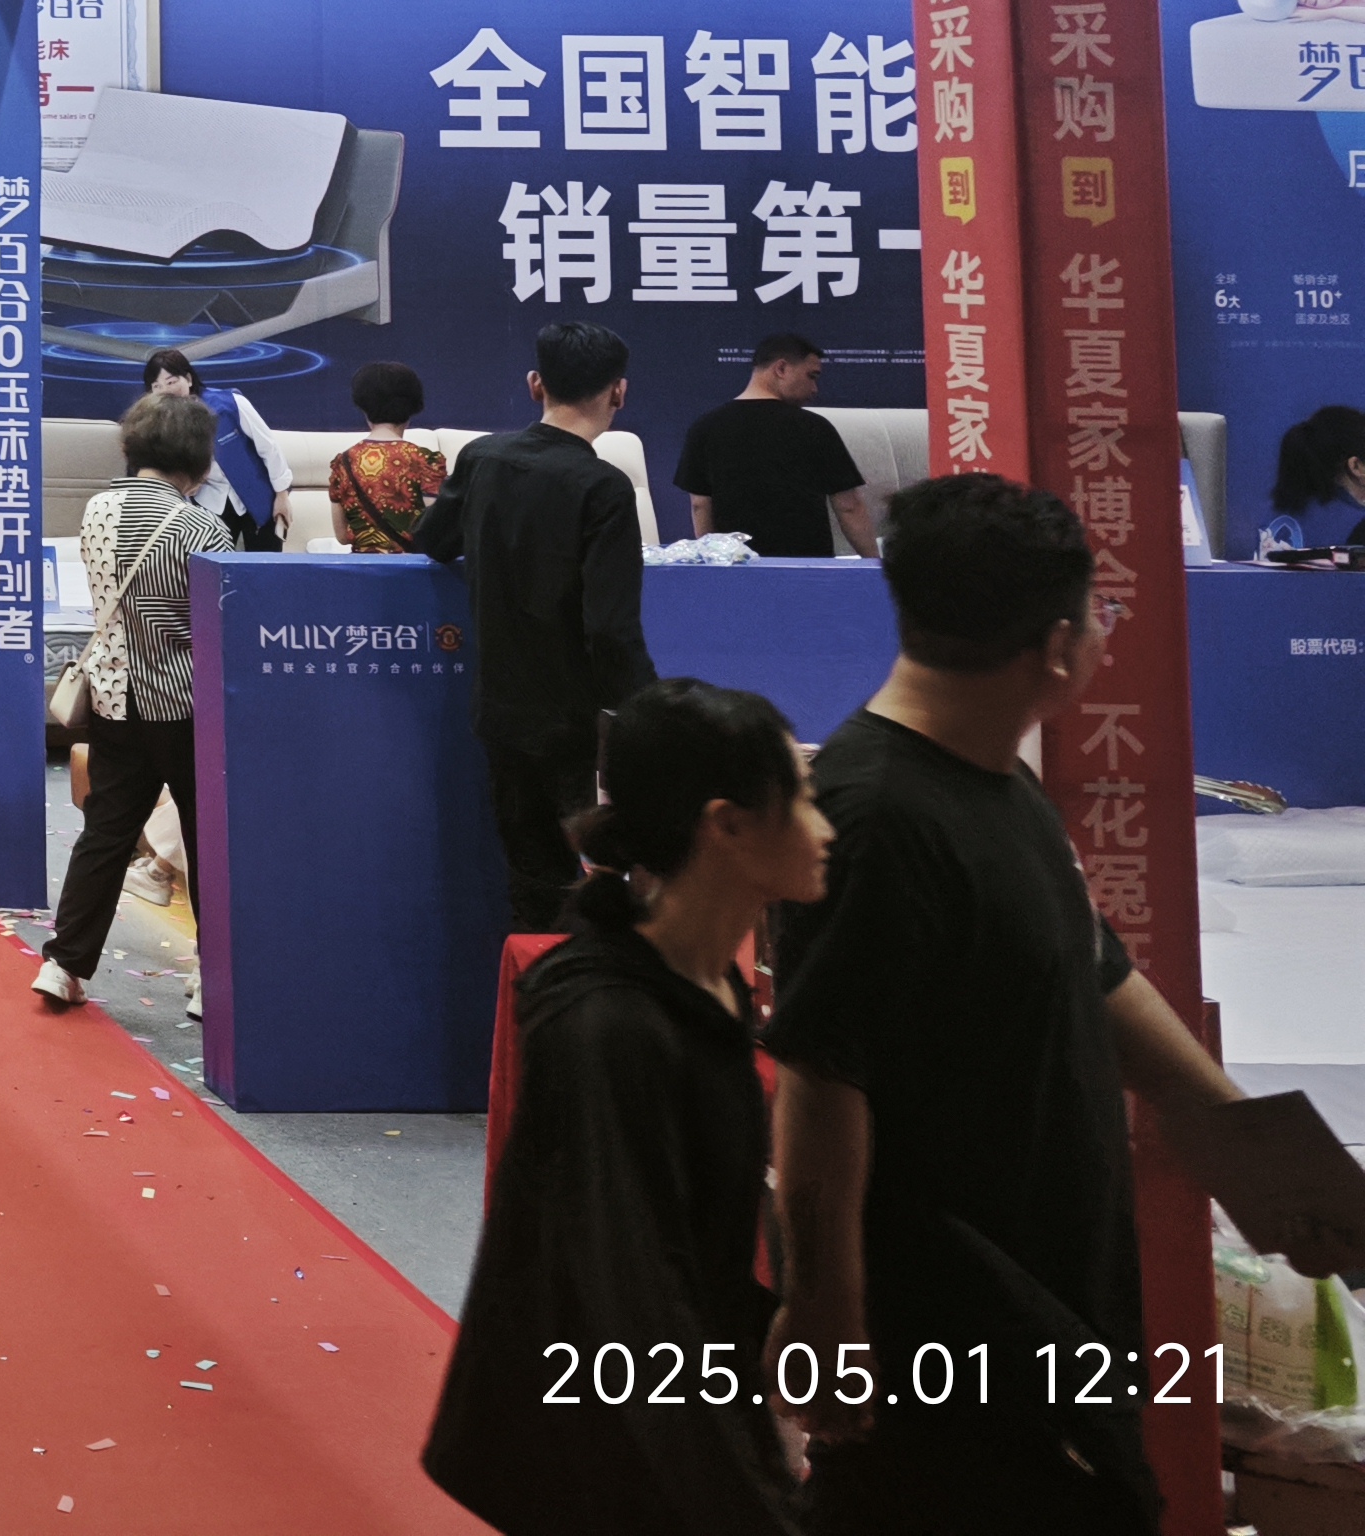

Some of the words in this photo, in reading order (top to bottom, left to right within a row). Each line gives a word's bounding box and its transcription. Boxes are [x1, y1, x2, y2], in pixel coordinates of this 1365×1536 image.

[429, 27, 919, 154] 全国智能
[1215, 273, 1238, 285] 全球
[1214, 288, 1241, 309] 6大
[1216, 312, 1262, 325] 生产基地
[1295, 312, 1351, 325] 国家及地区
[259, 623, 343, 650] MLILY
[344, 623, 419, 657] 梦百合
[262, 662, 466, 675] 曼联全球官方合作伙伴
